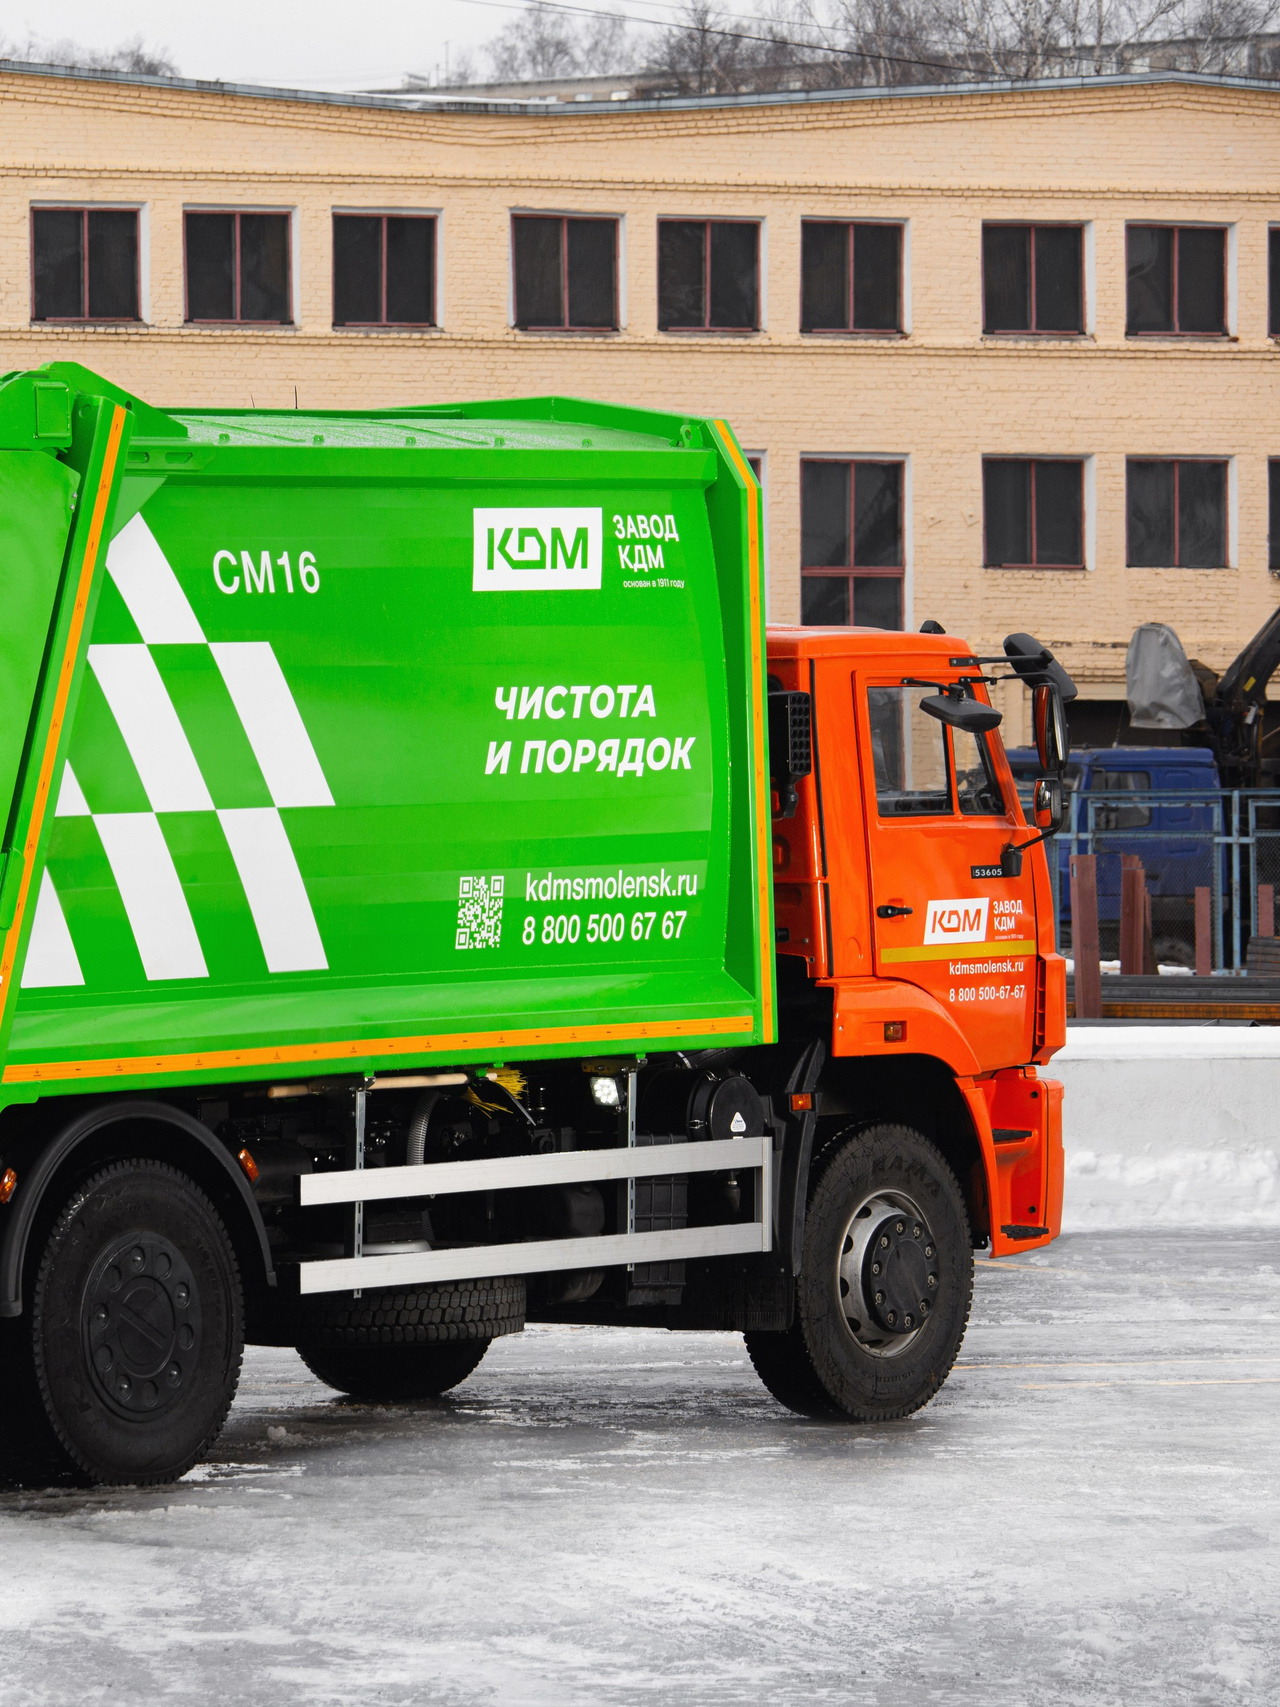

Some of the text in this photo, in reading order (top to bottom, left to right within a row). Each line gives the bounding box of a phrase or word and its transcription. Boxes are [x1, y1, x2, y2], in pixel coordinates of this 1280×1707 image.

[612, 514, 680, 542] ЗАВОД
[617, 545, 665, 573] КДМ
[622, 580, 651, 588] основан
[670, 579, 685, 589] году
[495, 684, 657, 720] ЧИСТОТА
[484, 737, 697, 777] И ПОРЯДОК
[974, 868, 1003, 877] 53605
[525, 868, 698, 902] kdmsmolensk.ru
[992, 899, 1024, 915] ЗАВОД
[522, 910, 688, 945] 8 800 500 67 67
[993, 916, 1016, 932] КДМ
[949, 959, 1025, 975] kdmsmolensk.ru
[949, 984, 1025, 1002] 8 800 500-67-67
